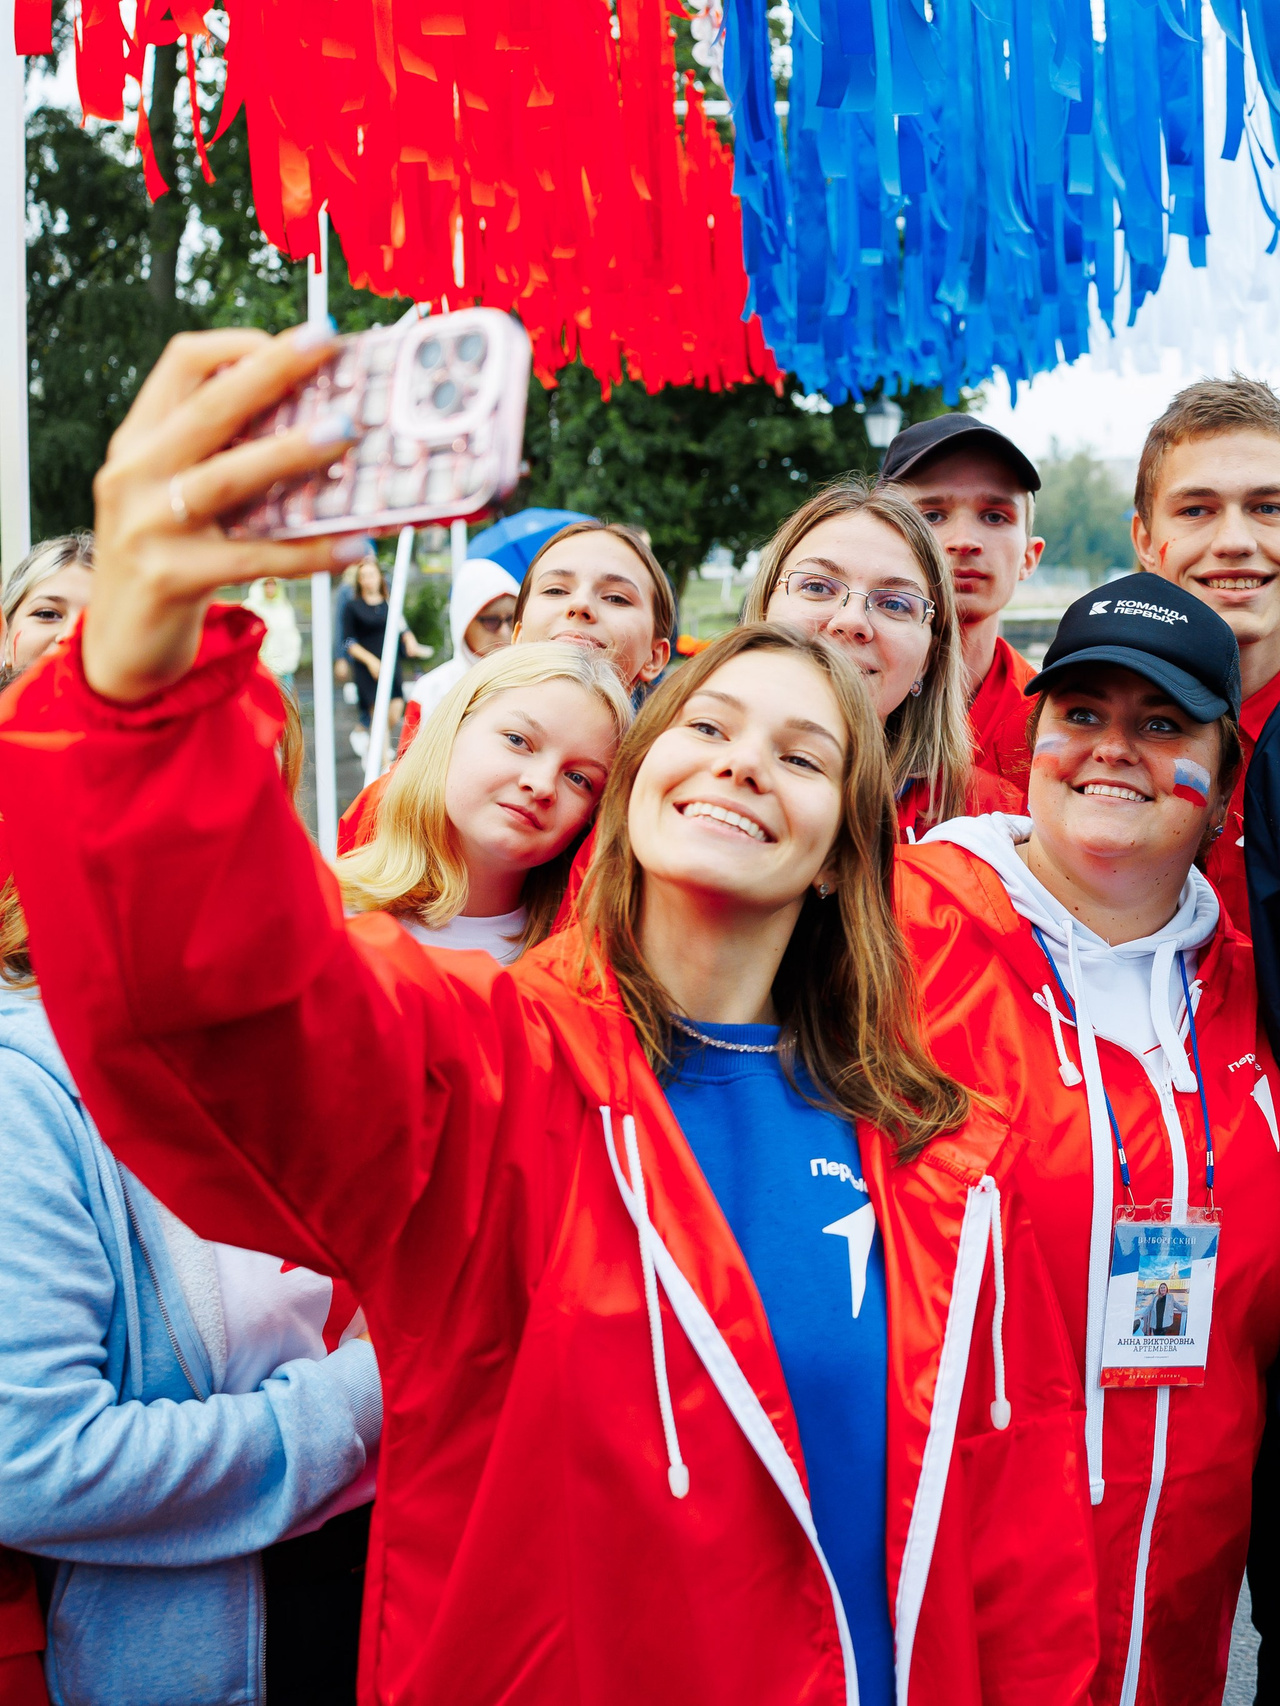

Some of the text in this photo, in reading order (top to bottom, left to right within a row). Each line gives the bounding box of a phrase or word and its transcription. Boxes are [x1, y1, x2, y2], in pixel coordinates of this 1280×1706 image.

[1113, 607, 1175, 625] ПЕРВЫХ
[1116, 599, 1189, 624] КОМАНДА
[1117, 1337, 1195, 1346] АННА ВИКТОРОВНА
[1132, 1345, 1178, 1353] АРТЕМЬЕВА
